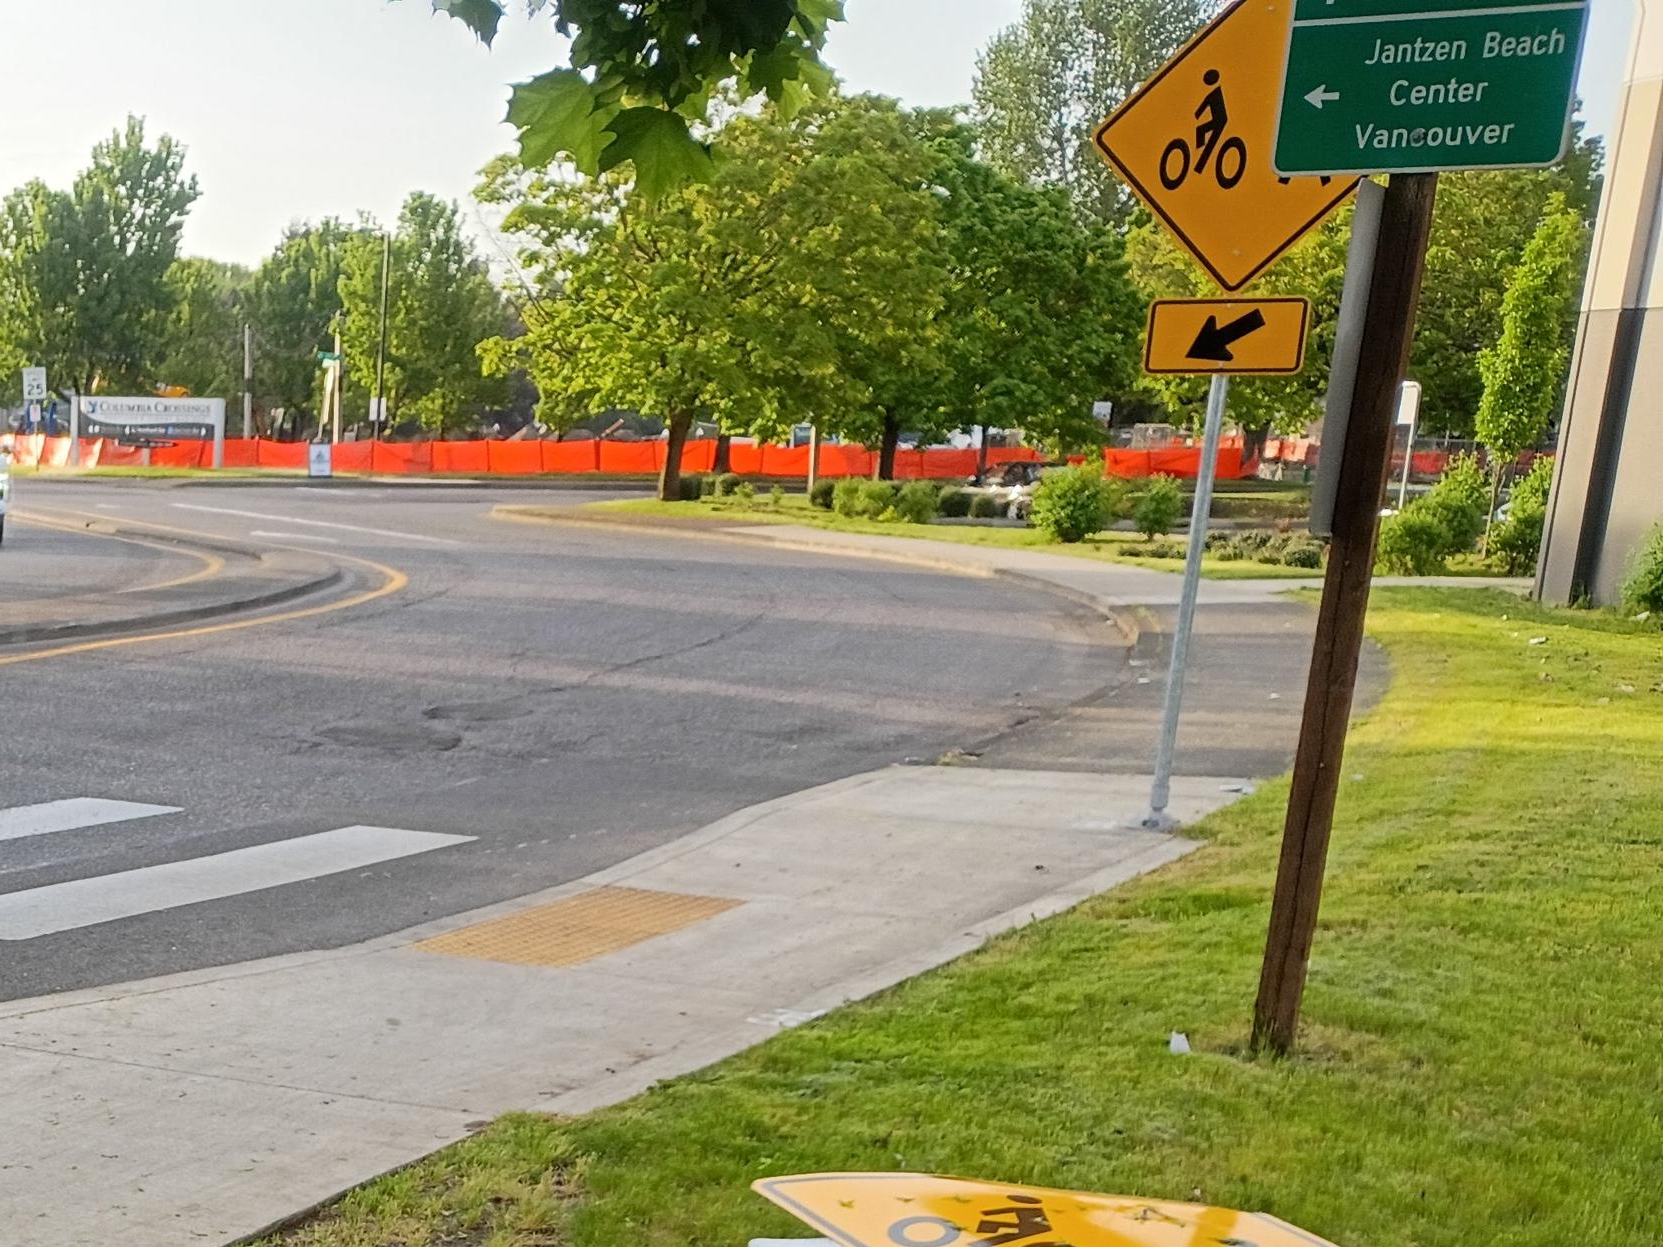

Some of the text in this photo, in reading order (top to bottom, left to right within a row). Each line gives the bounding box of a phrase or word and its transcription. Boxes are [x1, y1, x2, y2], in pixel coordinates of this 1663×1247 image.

[1364, 27, 1566, 65] Jantzen Beach
[1390, 77, 1489, 106] Center
[1355, 122, 1515, 149] Vancouver
[27, 383, 44, 396] 25
